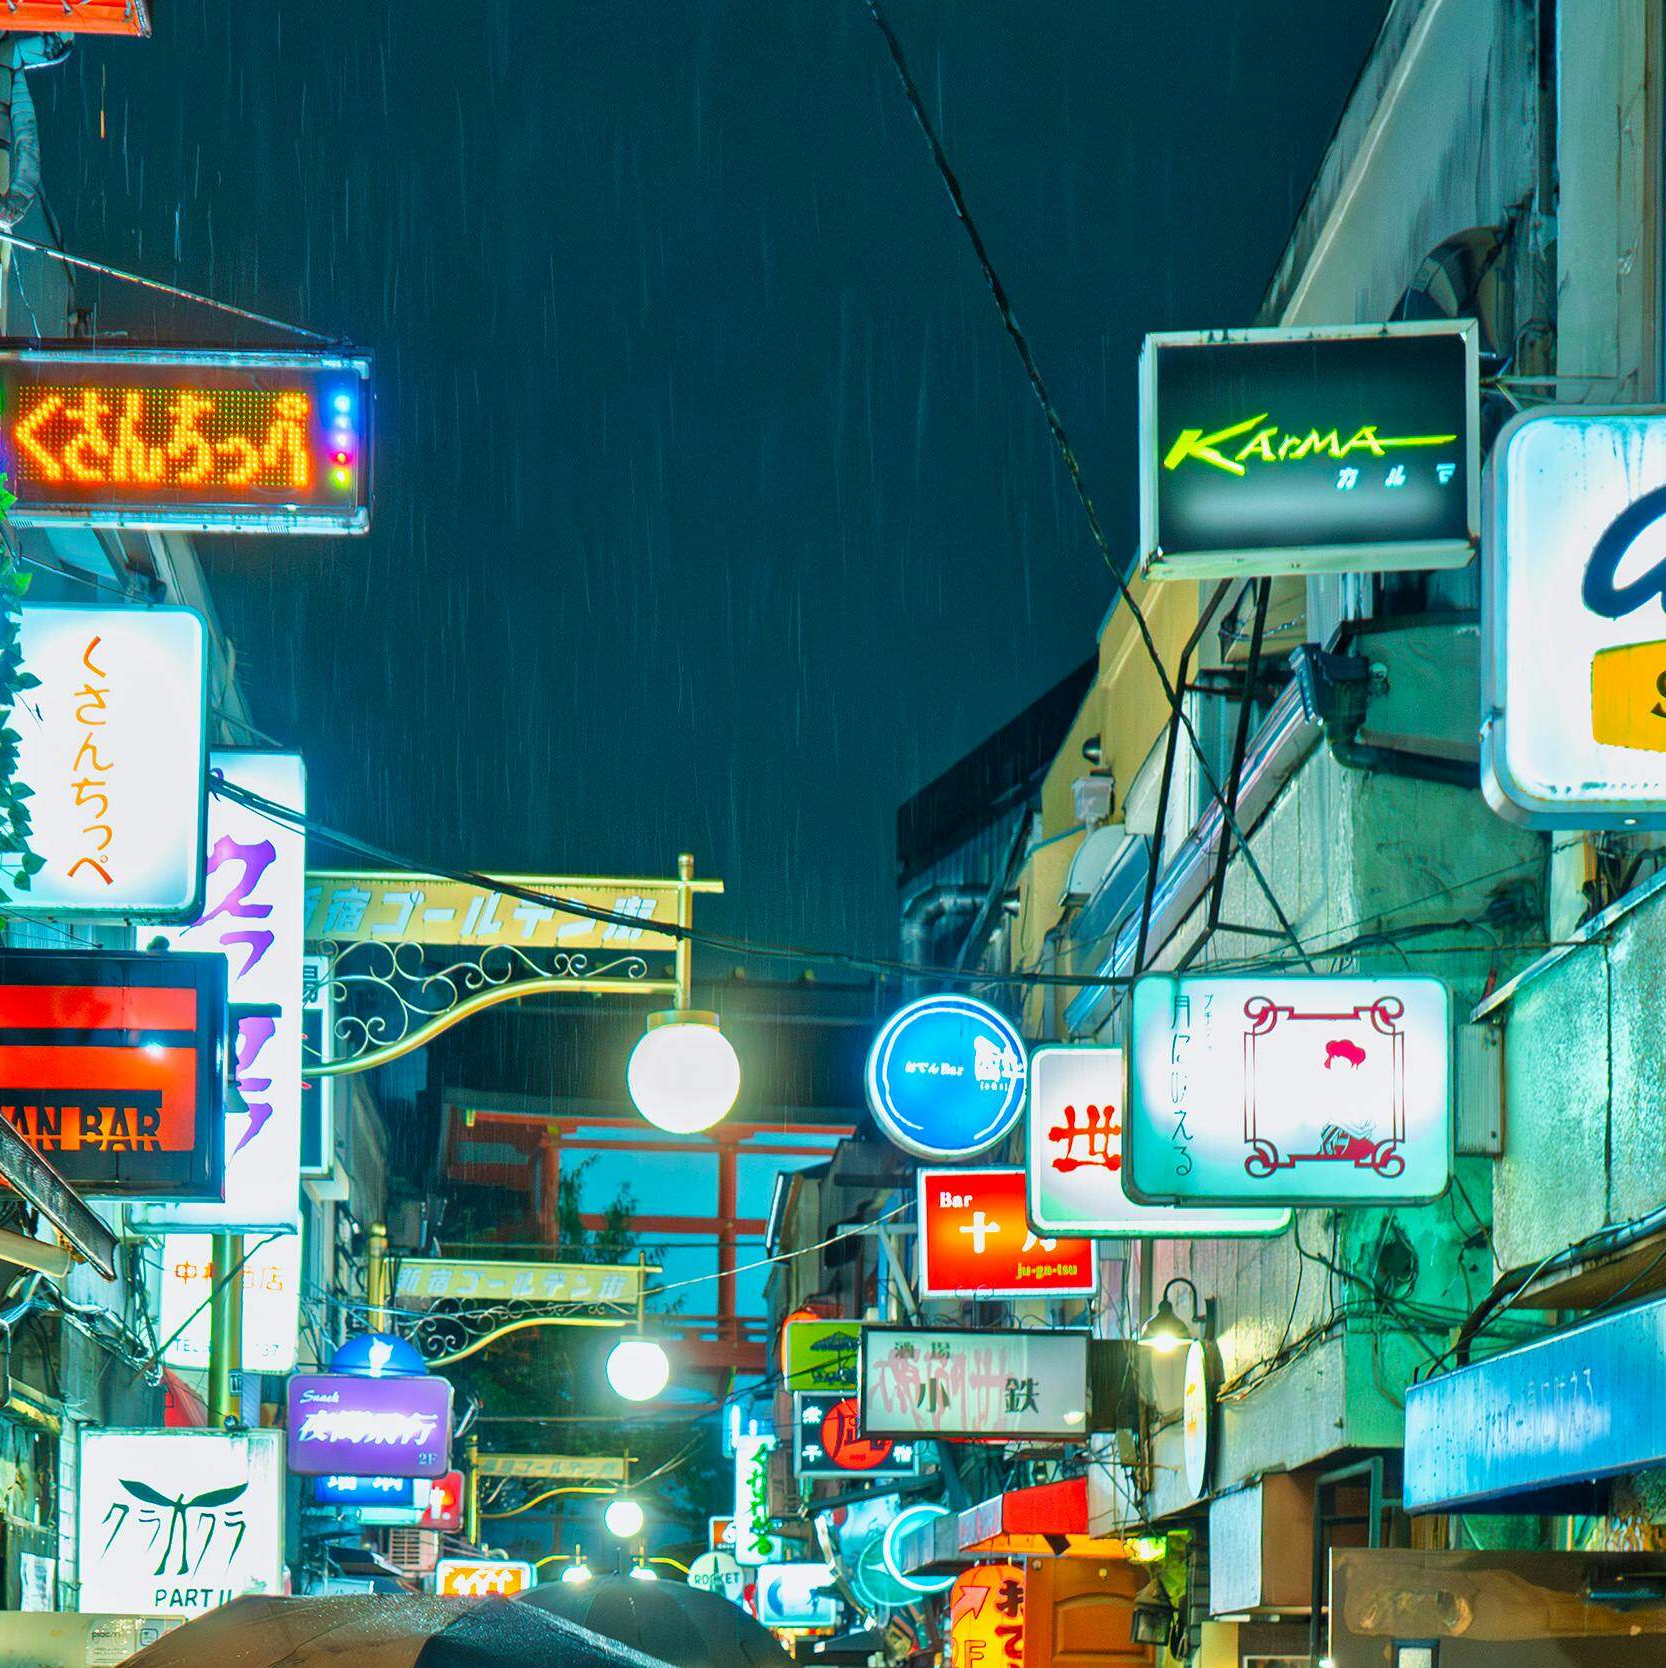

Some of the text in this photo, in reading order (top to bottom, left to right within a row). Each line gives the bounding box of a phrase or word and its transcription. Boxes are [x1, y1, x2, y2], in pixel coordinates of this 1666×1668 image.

[15, 388, 311, 488] くさんちっぺ
[67, 635, 114, 886] くさんちっぺ
[80, 1106, 162, 1151] BAR
[939, 1191, 973, 1208] Bar
[917, 1376, 1039, 1414] 小鉄
[418, 1452, 437, 1465] 2F
[155, 1588, 213, 1608] PART
